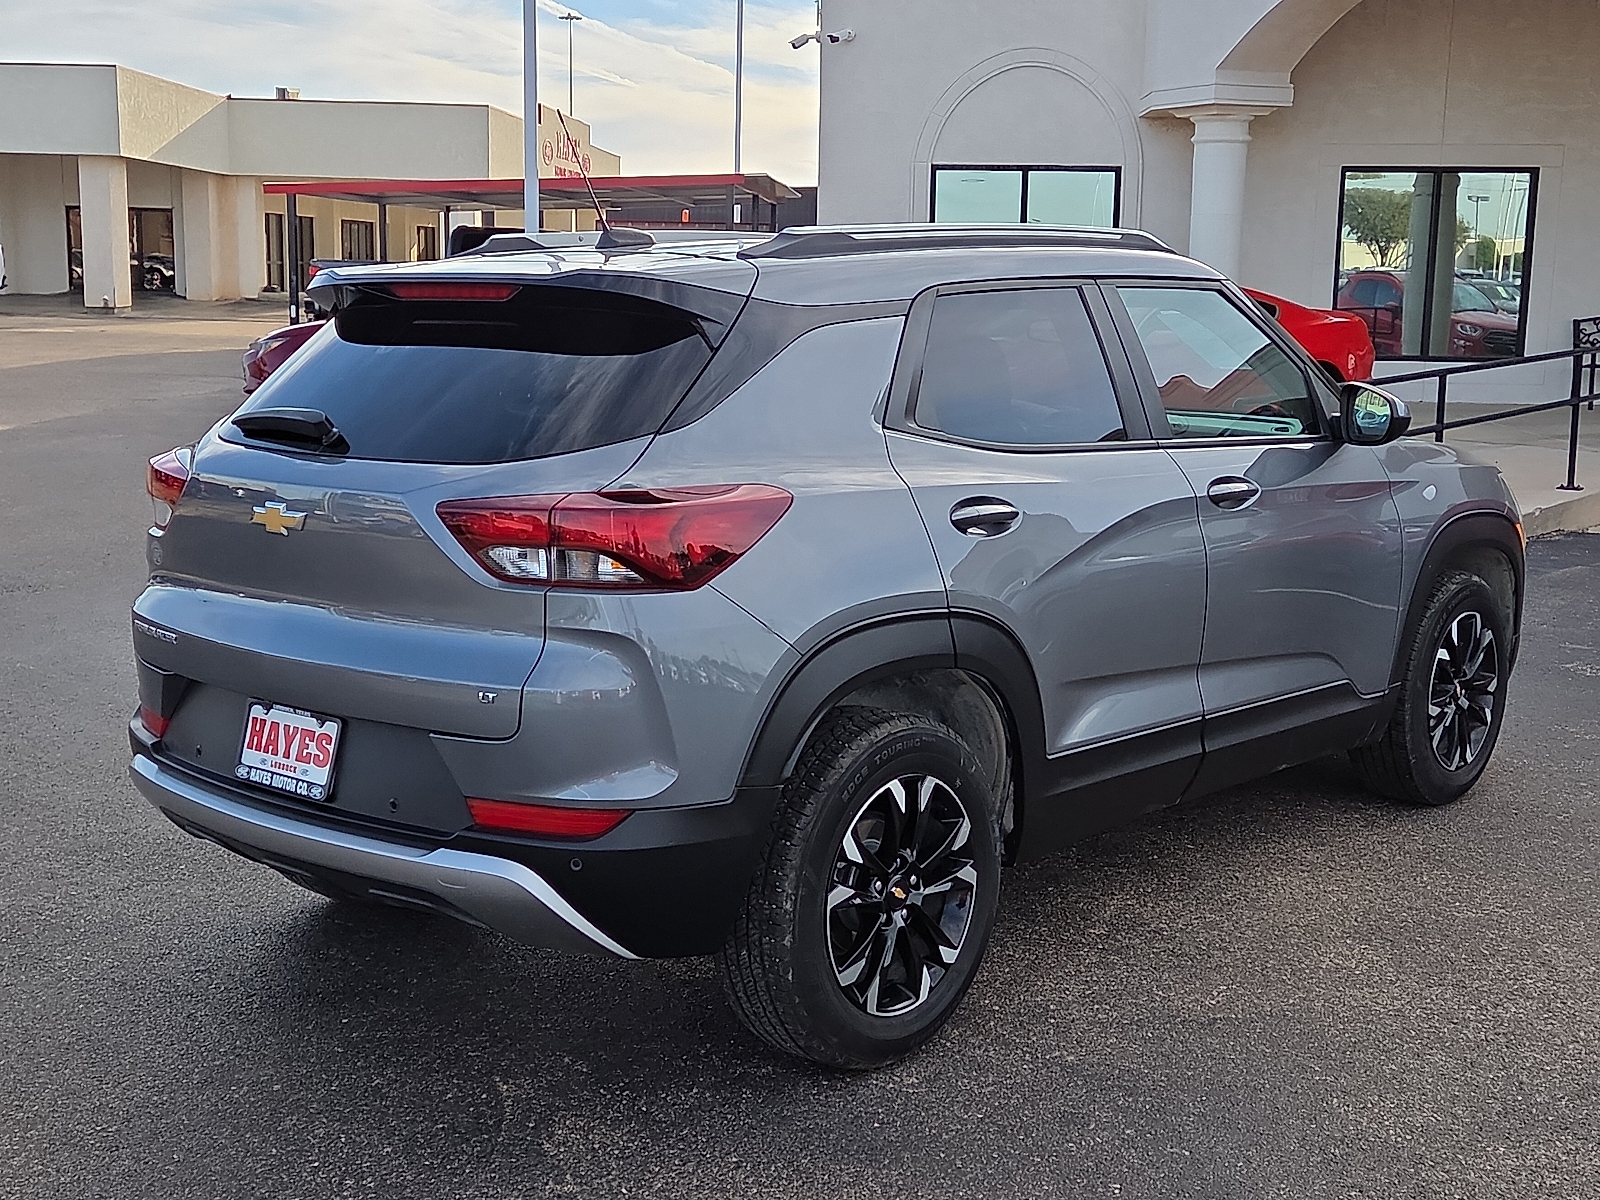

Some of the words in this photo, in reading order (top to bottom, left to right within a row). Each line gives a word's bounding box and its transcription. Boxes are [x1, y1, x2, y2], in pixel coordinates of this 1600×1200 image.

[478, 691, 498, 704] LT
[247, 716, 333, 769] HAYES
[250, 768, 272, 786] HAYES
[272, 774, 297, 792] MOTOR
[841, 766, 869, 802] EDGE
[874, 738, 921, 764] TOURING
